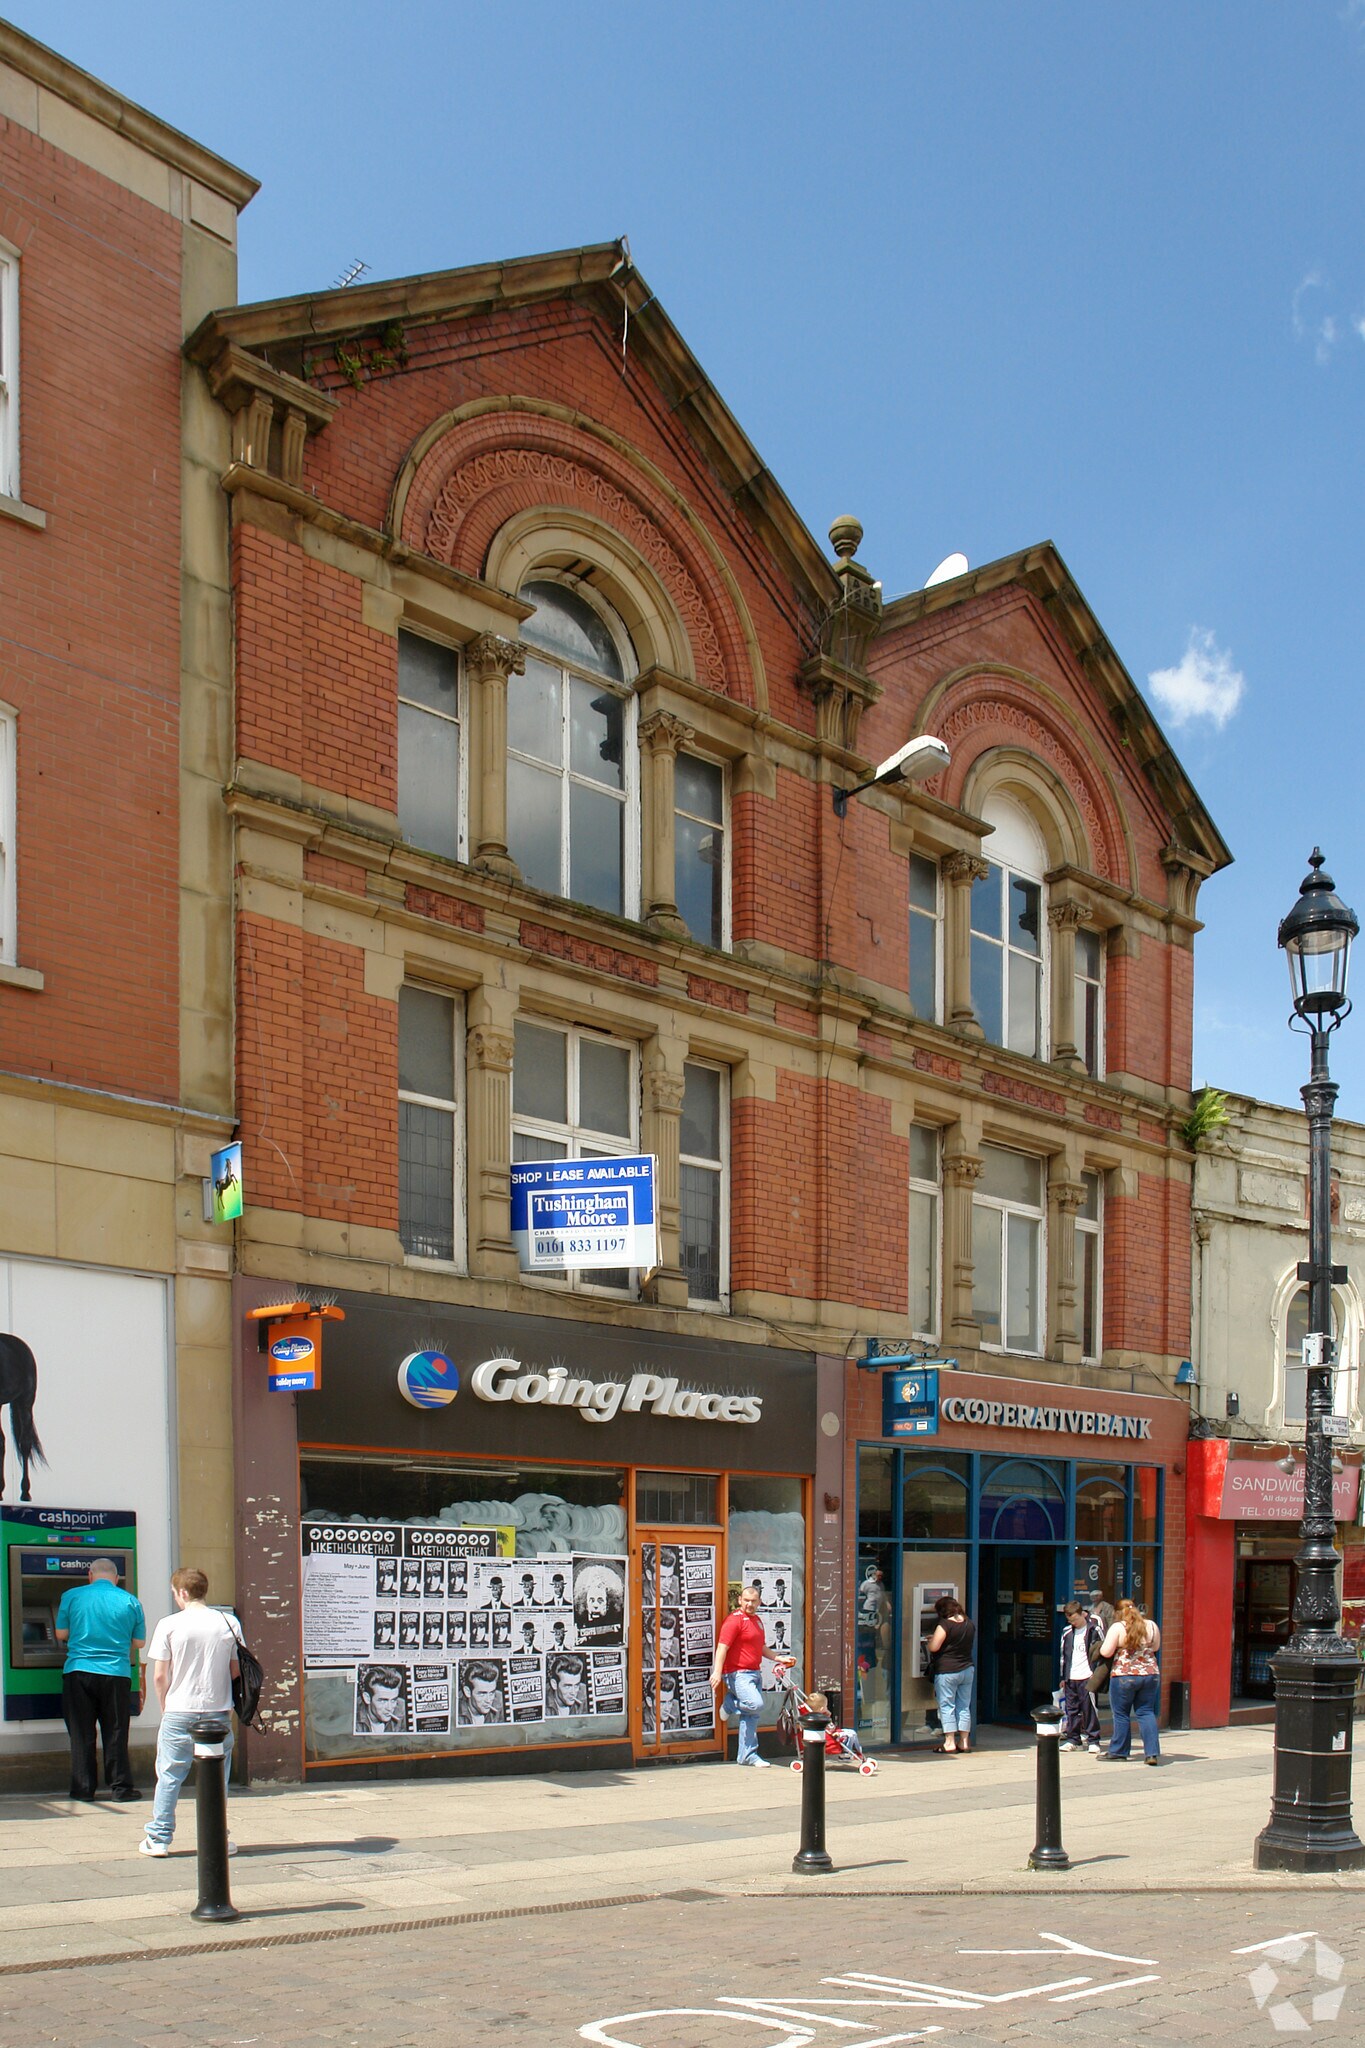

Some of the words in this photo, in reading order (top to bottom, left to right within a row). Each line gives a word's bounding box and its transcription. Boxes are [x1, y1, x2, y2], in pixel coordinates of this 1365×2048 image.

[512, 1172, 542, 1184] SHOP
[546, 1169, 584, 1182] LEASE
[587, 1165, 650, 1180] AVAILABLE
[534, 1194, 627, 1214] Tushingham
[566, 1210, 617, 1227] Moore
[537, 1238, 565, 1254] 0161
[569, 1239, 592, 1253] 833
[597, 1238, 626, 1252] 1197
[273, 1346, 291, 1356] Going
[290, 1343, 311, 1353] Places
[275, 1377, 292, 1387] holiday
[291, 1377, 307, 1386] money
[471, 1357, 626, 1422] Going
[622, 1373, 763, 1423] Places
[904, 1387, 916, 1396] 24
[1332, 1418, 1347, 1427] loading
[1232, 1477, 1305, 1493] SANDWIC
[1332, 1482, 1351, 1494] AR
[1275, 1495, 1288, 1503] day
[1268, 1507, 1299, 1517] 01942
[39, 1511, 105, 1525] cashpoint
[61, 1560, 91, 1569] cashpo
[595, 1676, 621, 1685] LIGHTS
[513, 1684, 541, 1693] LIGHTS
[416, 1693, 447, 1702] LIGHTS
